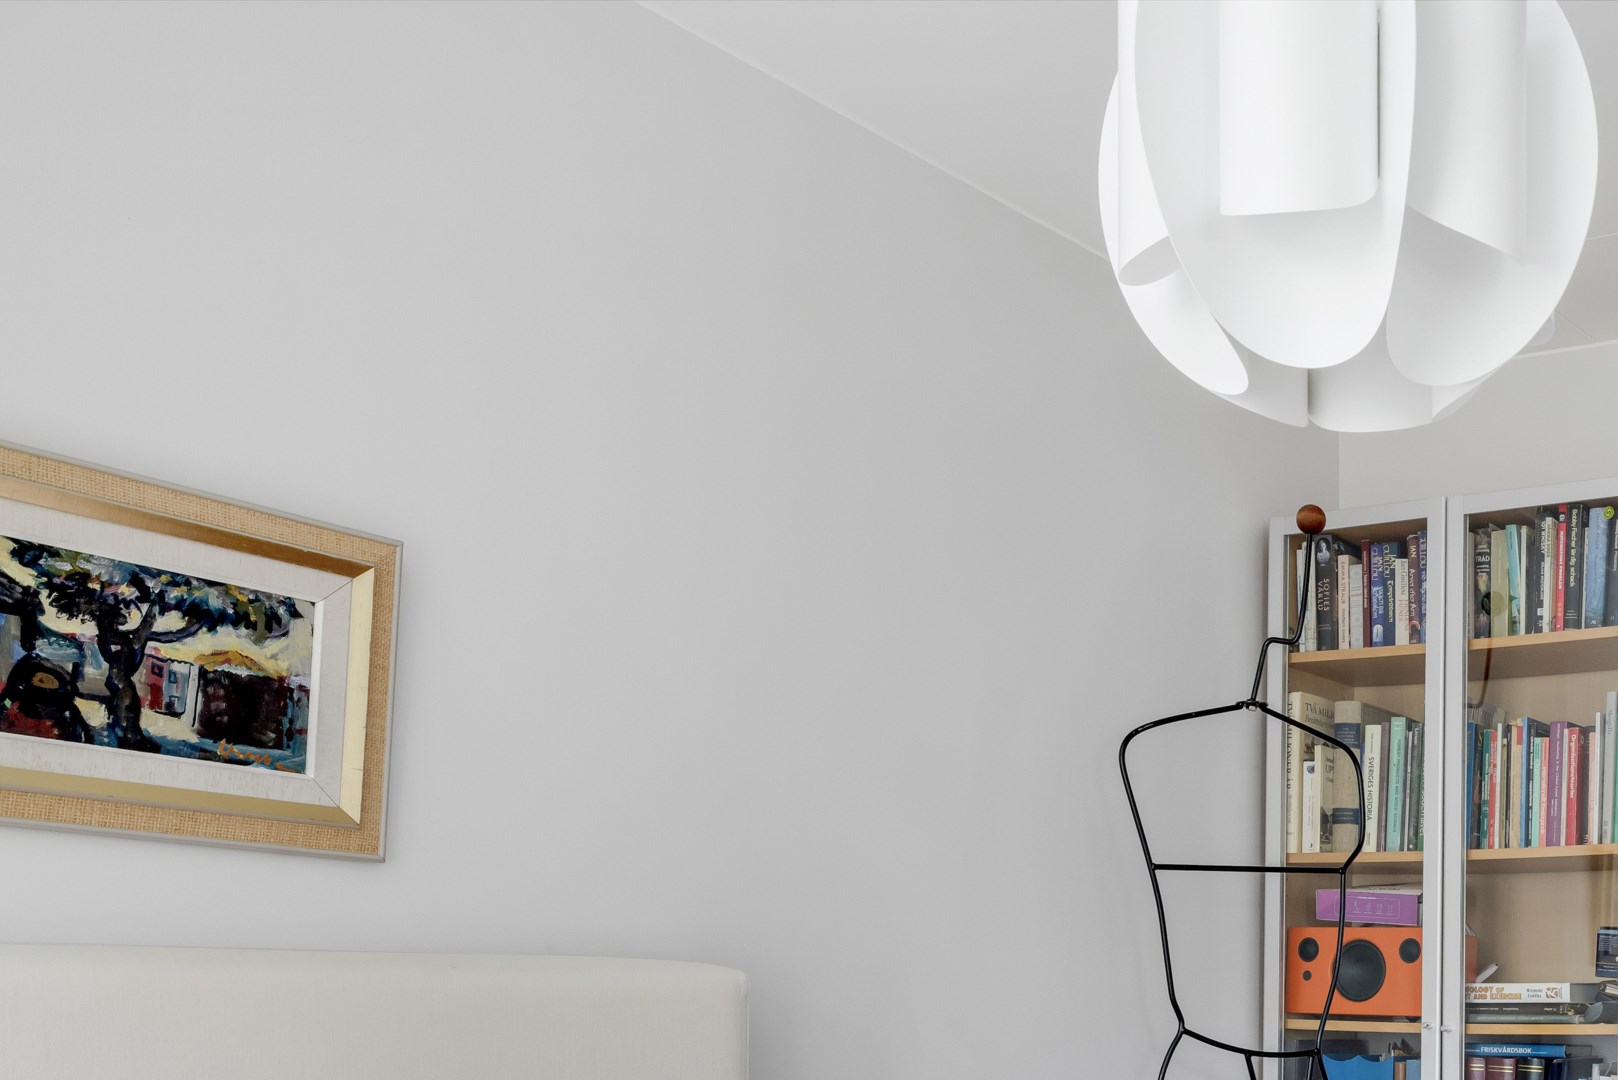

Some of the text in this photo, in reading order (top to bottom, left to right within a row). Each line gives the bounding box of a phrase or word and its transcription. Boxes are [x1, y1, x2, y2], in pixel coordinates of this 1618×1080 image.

[1475, 554, 1490, 562] TRÅD
[1569, 734, 1577, 799] Organisationsteorier
[1366, 757, 1375, 821] SVERIGES HISTORIA
[1480, 1045, 1532, 1054] FRISKVÅRDSBOK
